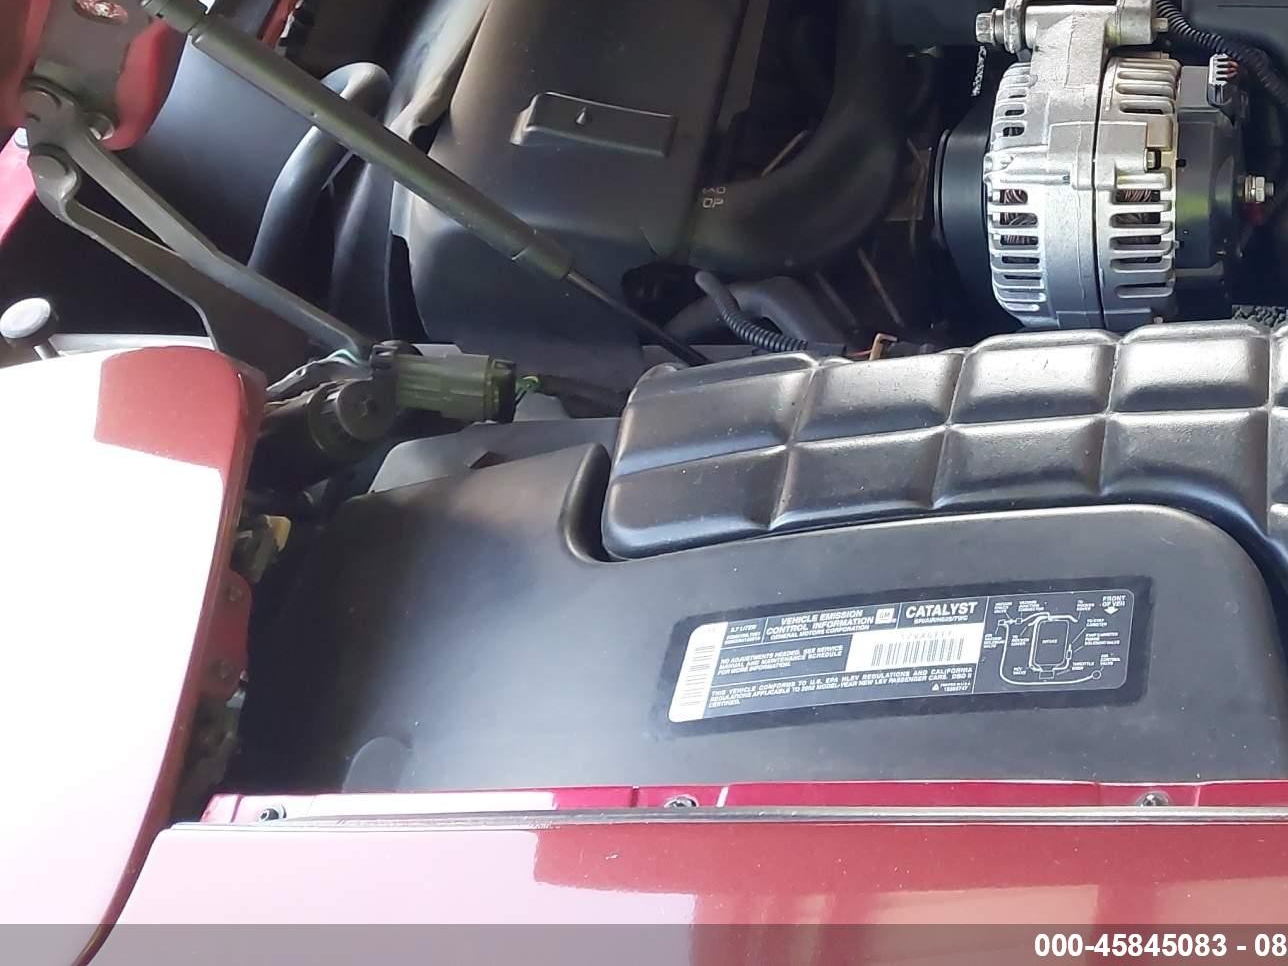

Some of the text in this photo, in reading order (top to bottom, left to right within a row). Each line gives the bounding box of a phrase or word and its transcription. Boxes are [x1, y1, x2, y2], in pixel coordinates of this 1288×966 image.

[780, 609, 863, 625] VEHICLE EMISSION
[905, 601, 978, 619] CATALYST
[767, 616, 874, 635] CONTROL INFORMATION
[930, 666, 974, 675] CALIFORNIA
